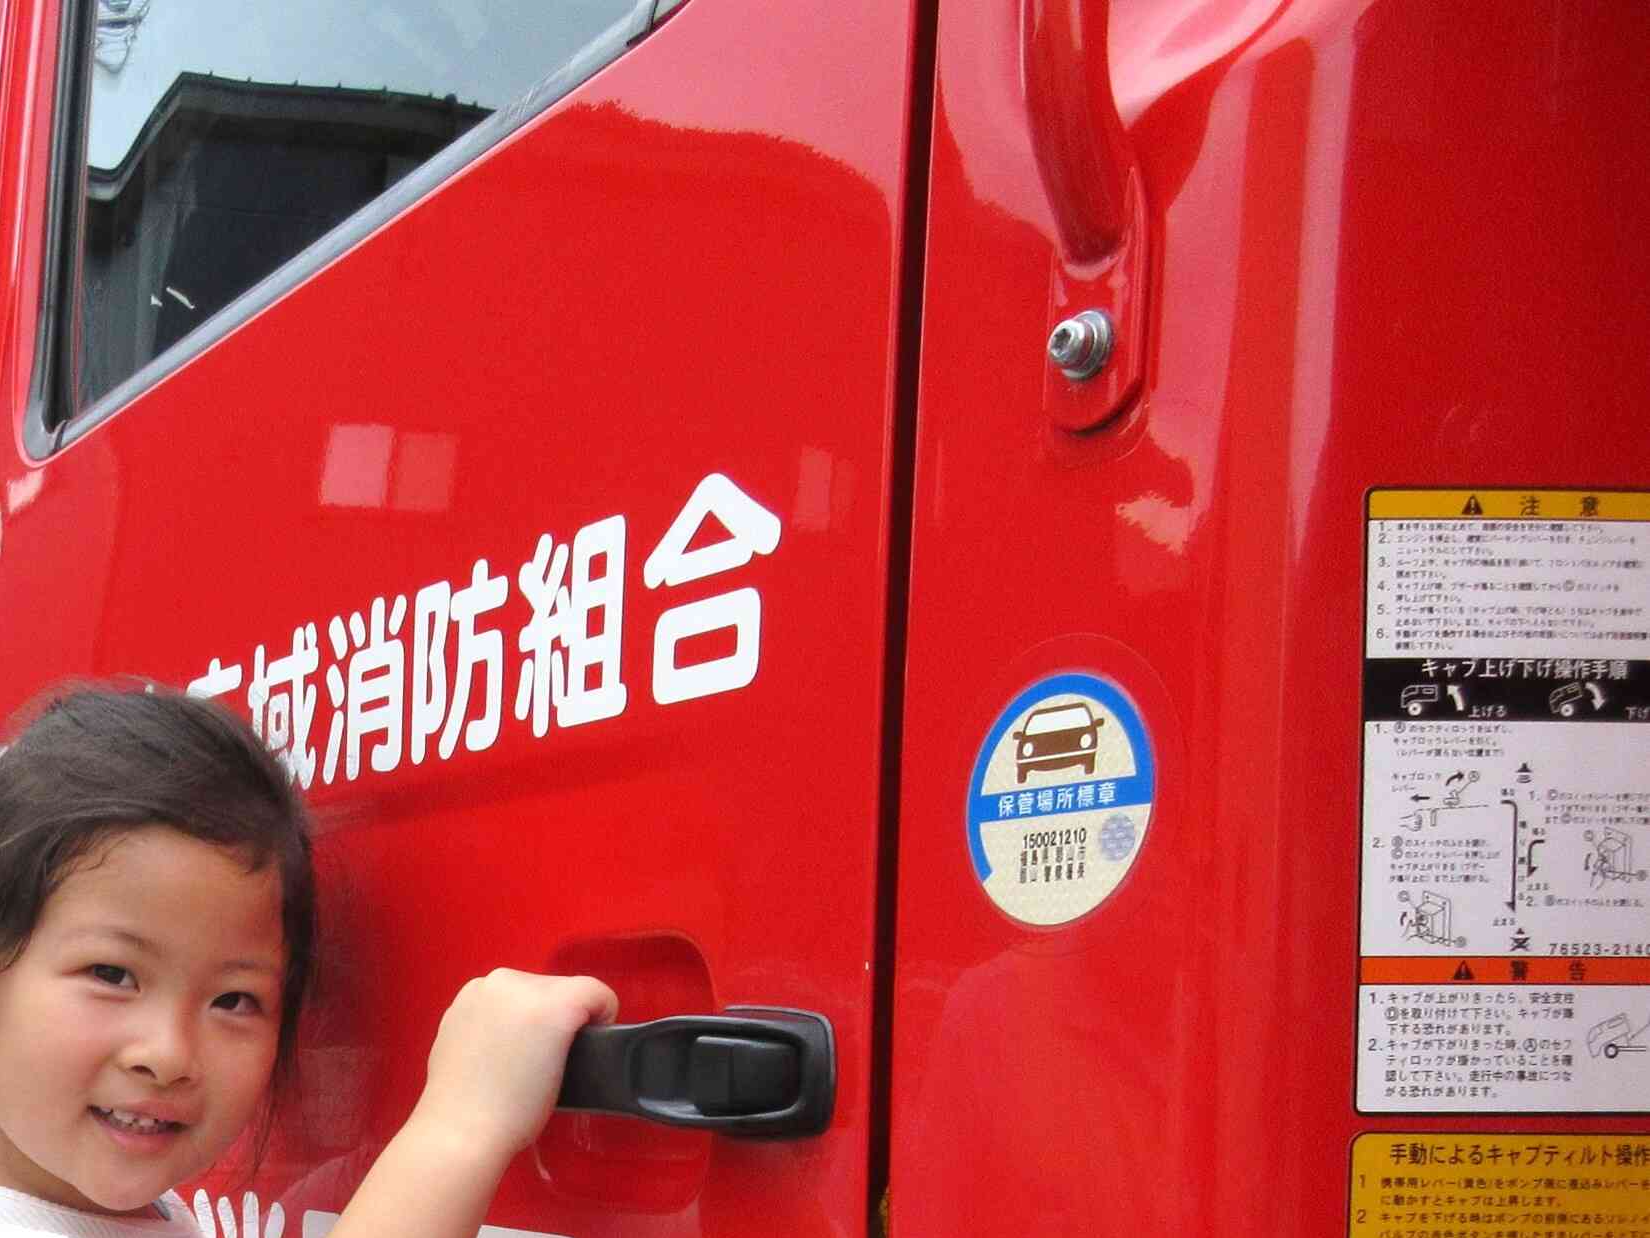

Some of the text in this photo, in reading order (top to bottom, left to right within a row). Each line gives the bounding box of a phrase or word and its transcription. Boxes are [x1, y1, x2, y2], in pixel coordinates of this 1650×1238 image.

[998, 782, 1117, 817] 保管場所標章
[1023, 828, 1087, 850] 150021210
